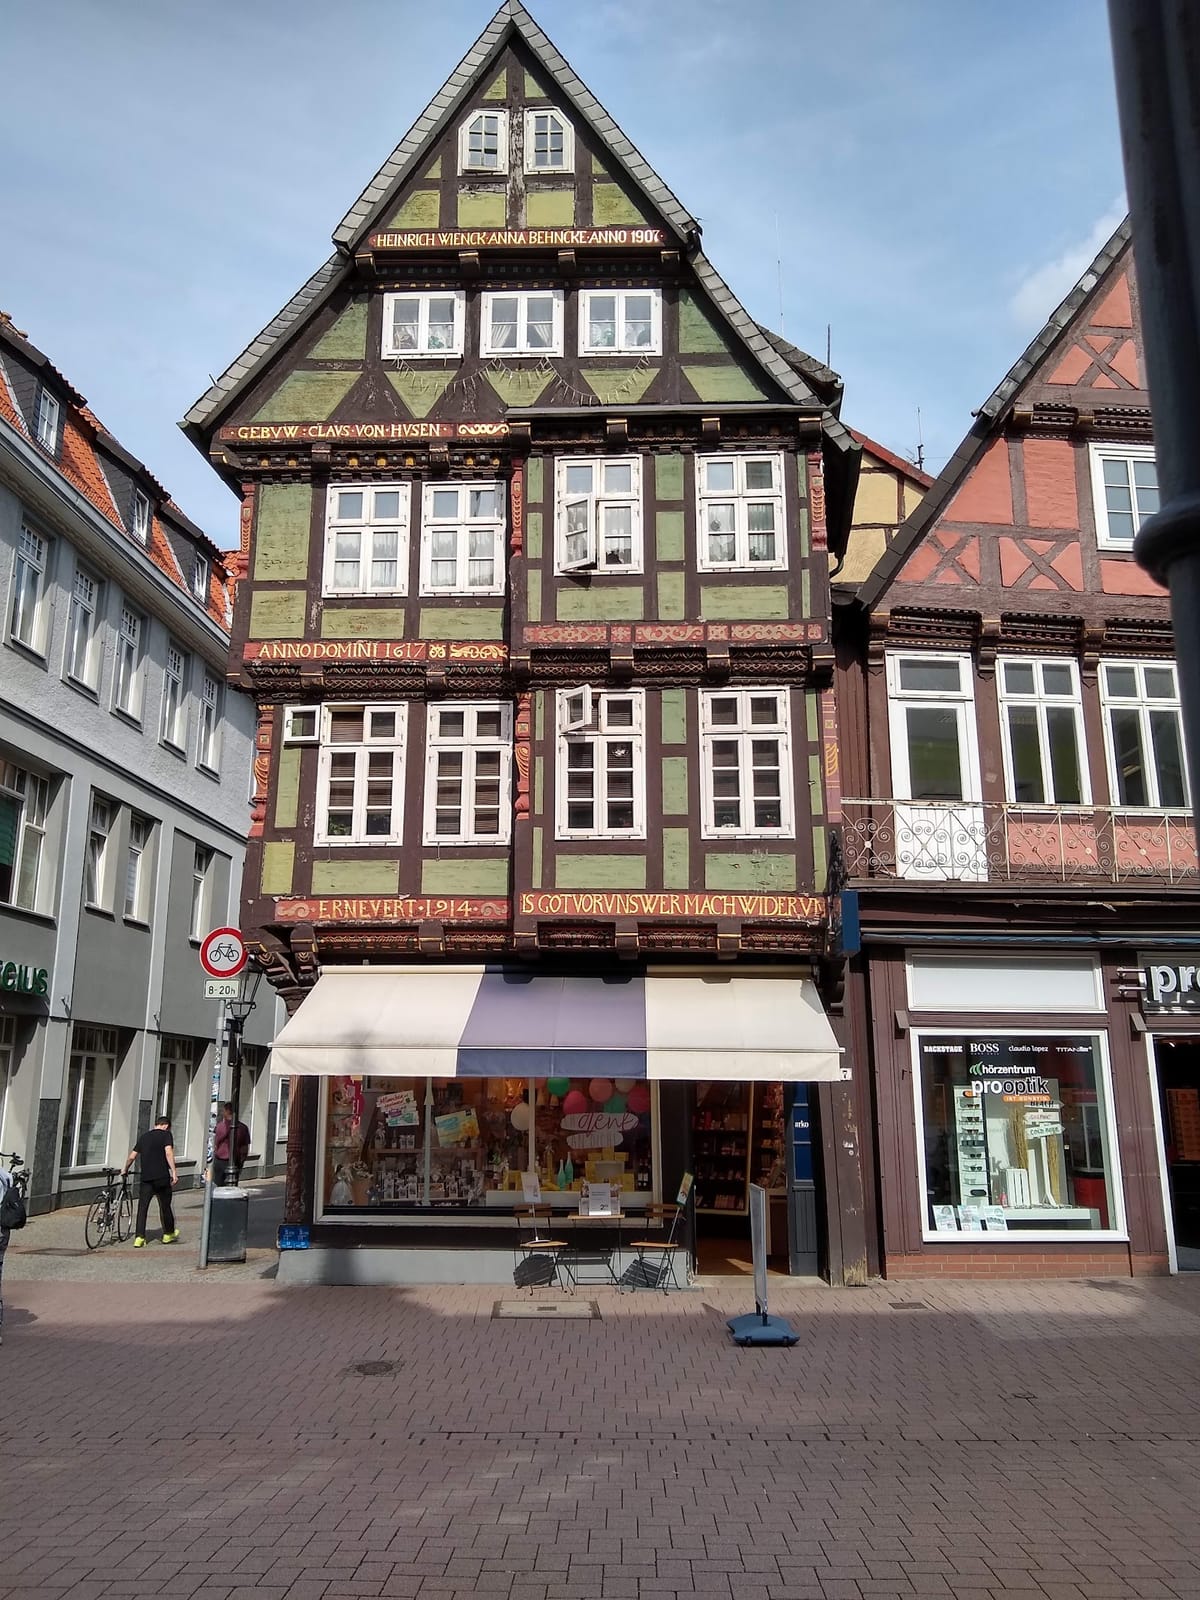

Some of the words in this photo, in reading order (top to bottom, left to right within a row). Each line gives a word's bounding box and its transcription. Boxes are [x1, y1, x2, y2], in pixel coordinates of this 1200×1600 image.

[377, 232, 435, 247] HEINRICH
[355, 424, 386, 438] VON
[259, 643, 311, 659] ANNO
[385, 642, 426, 658] 1617
[318, 899, 417, 919] ERNEVERT
[426, 900, 472, 918] 1914
[1149, 965, 1200, 1002] pr
[970, 1043, 1000, 1053] BOSS
[842, 1070, 848, 1079] 7
[982, 1064, 1036, 1075] hörzentrum
[971, 1077, 1050, 1096] prooptik
